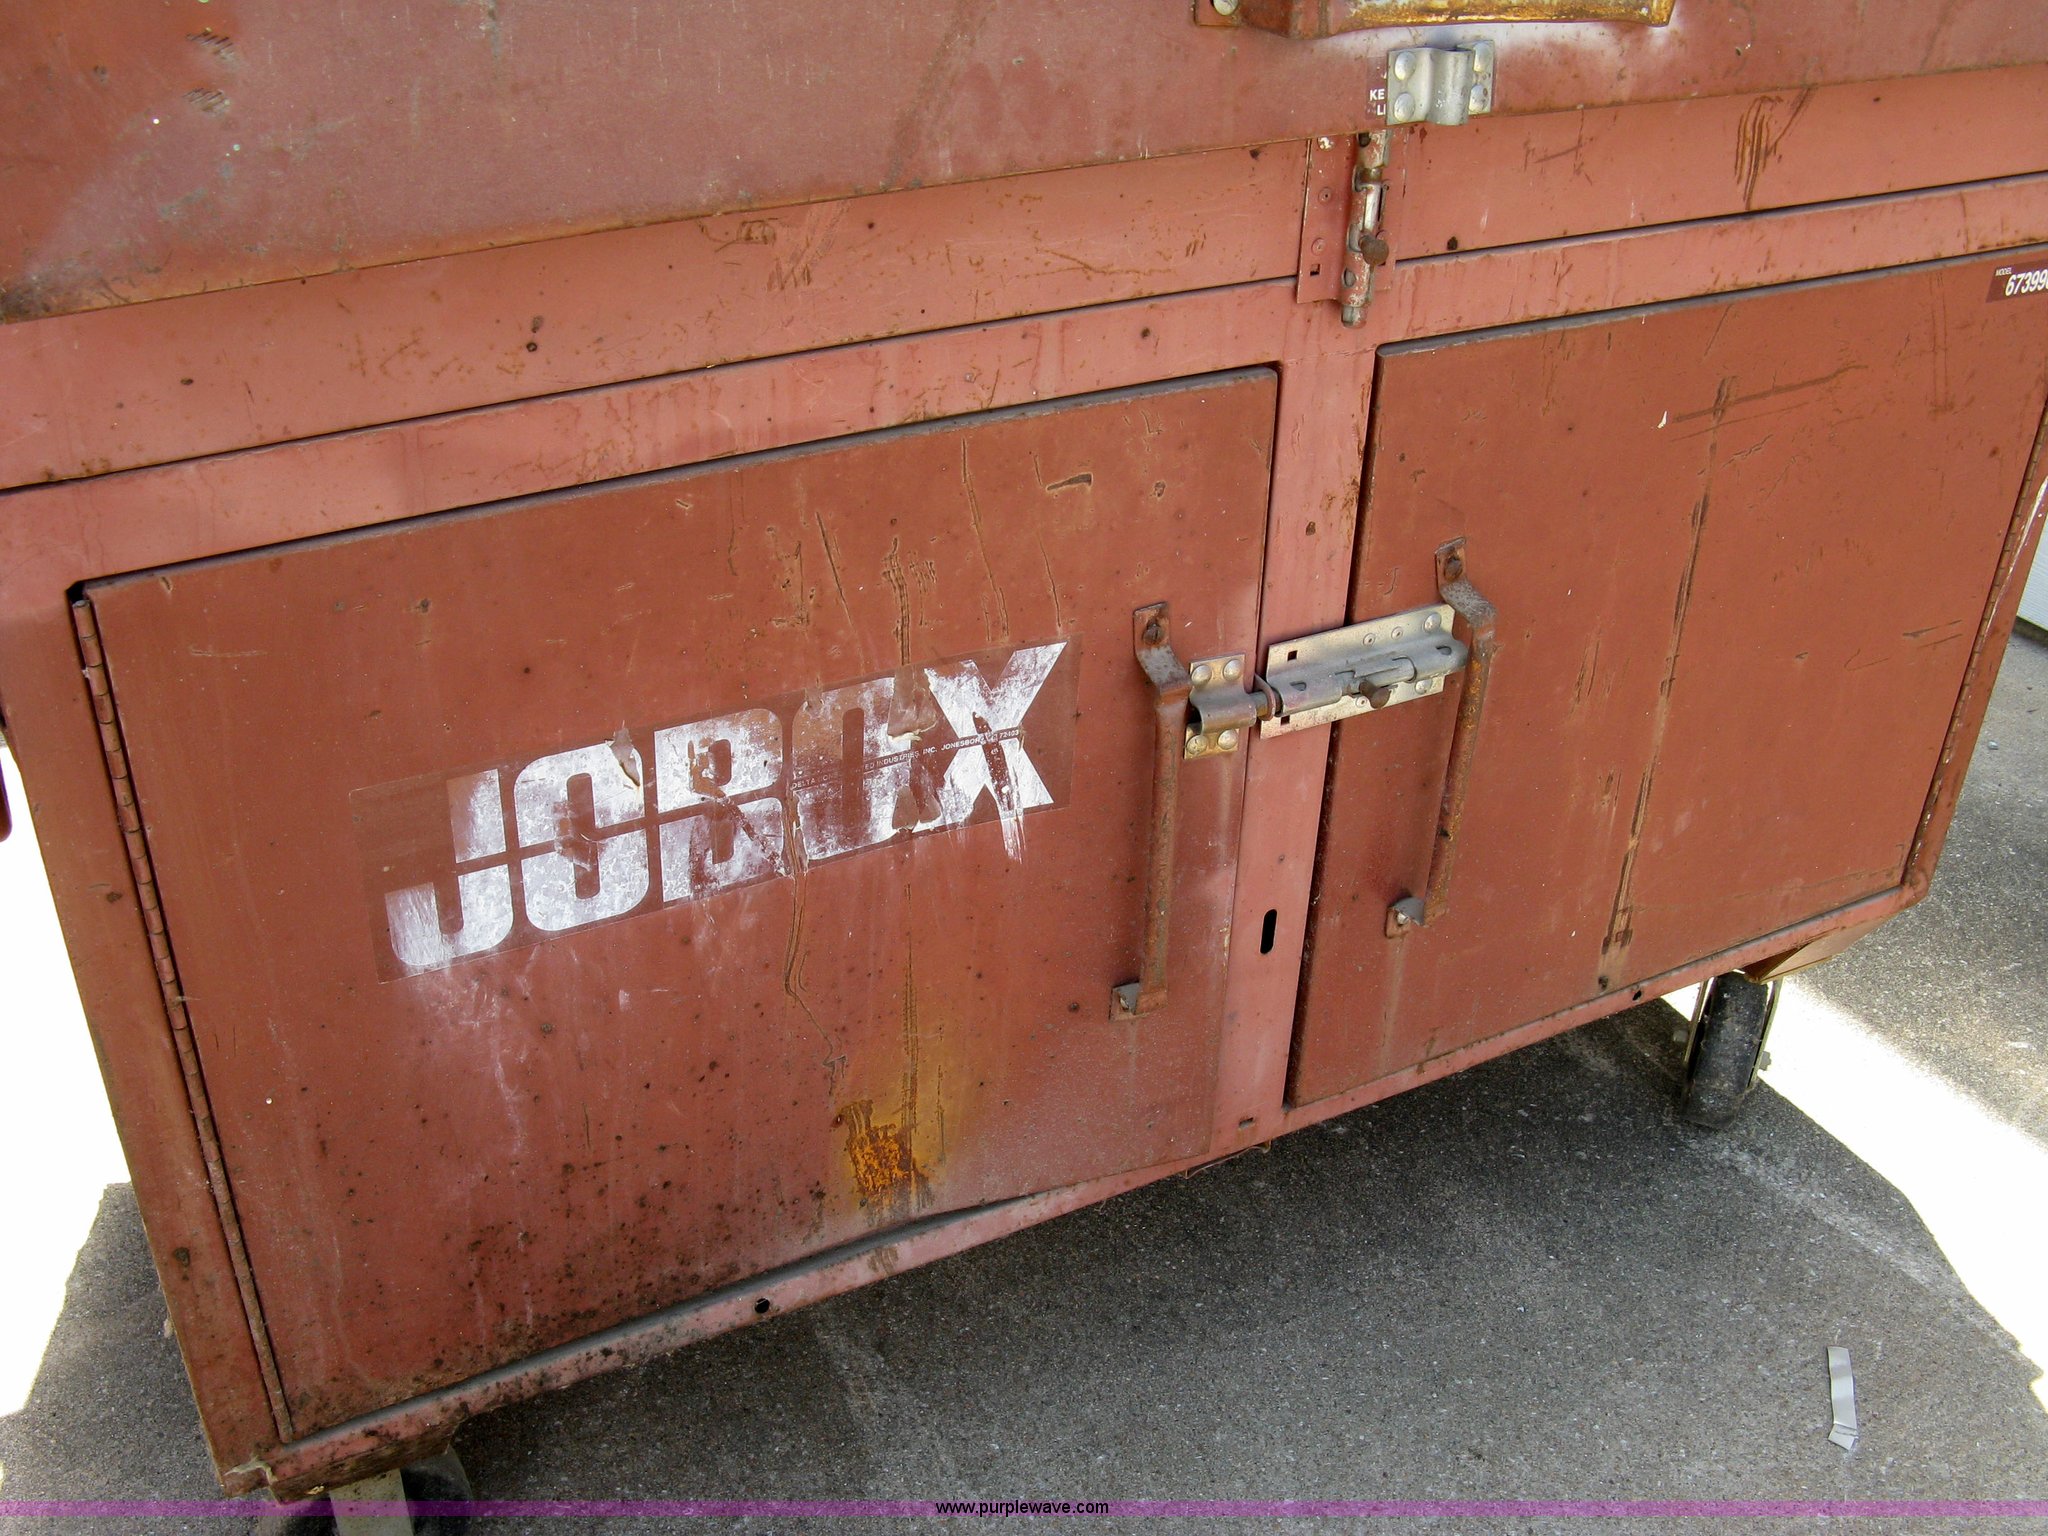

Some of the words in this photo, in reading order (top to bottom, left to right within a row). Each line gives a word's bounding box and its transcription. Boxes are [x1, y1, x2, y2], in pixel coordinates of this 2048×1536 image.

[1369, 89, 1385, 101] KE
[1995, 267, 2012, 276] MODEL
[2005, 269, 2048, 296] 67399
[791, 777, 816, 790] DELTA
[876, 749, 920, 768] INDUSTRIES
[385, 641, 1068, 967] JOBOX
